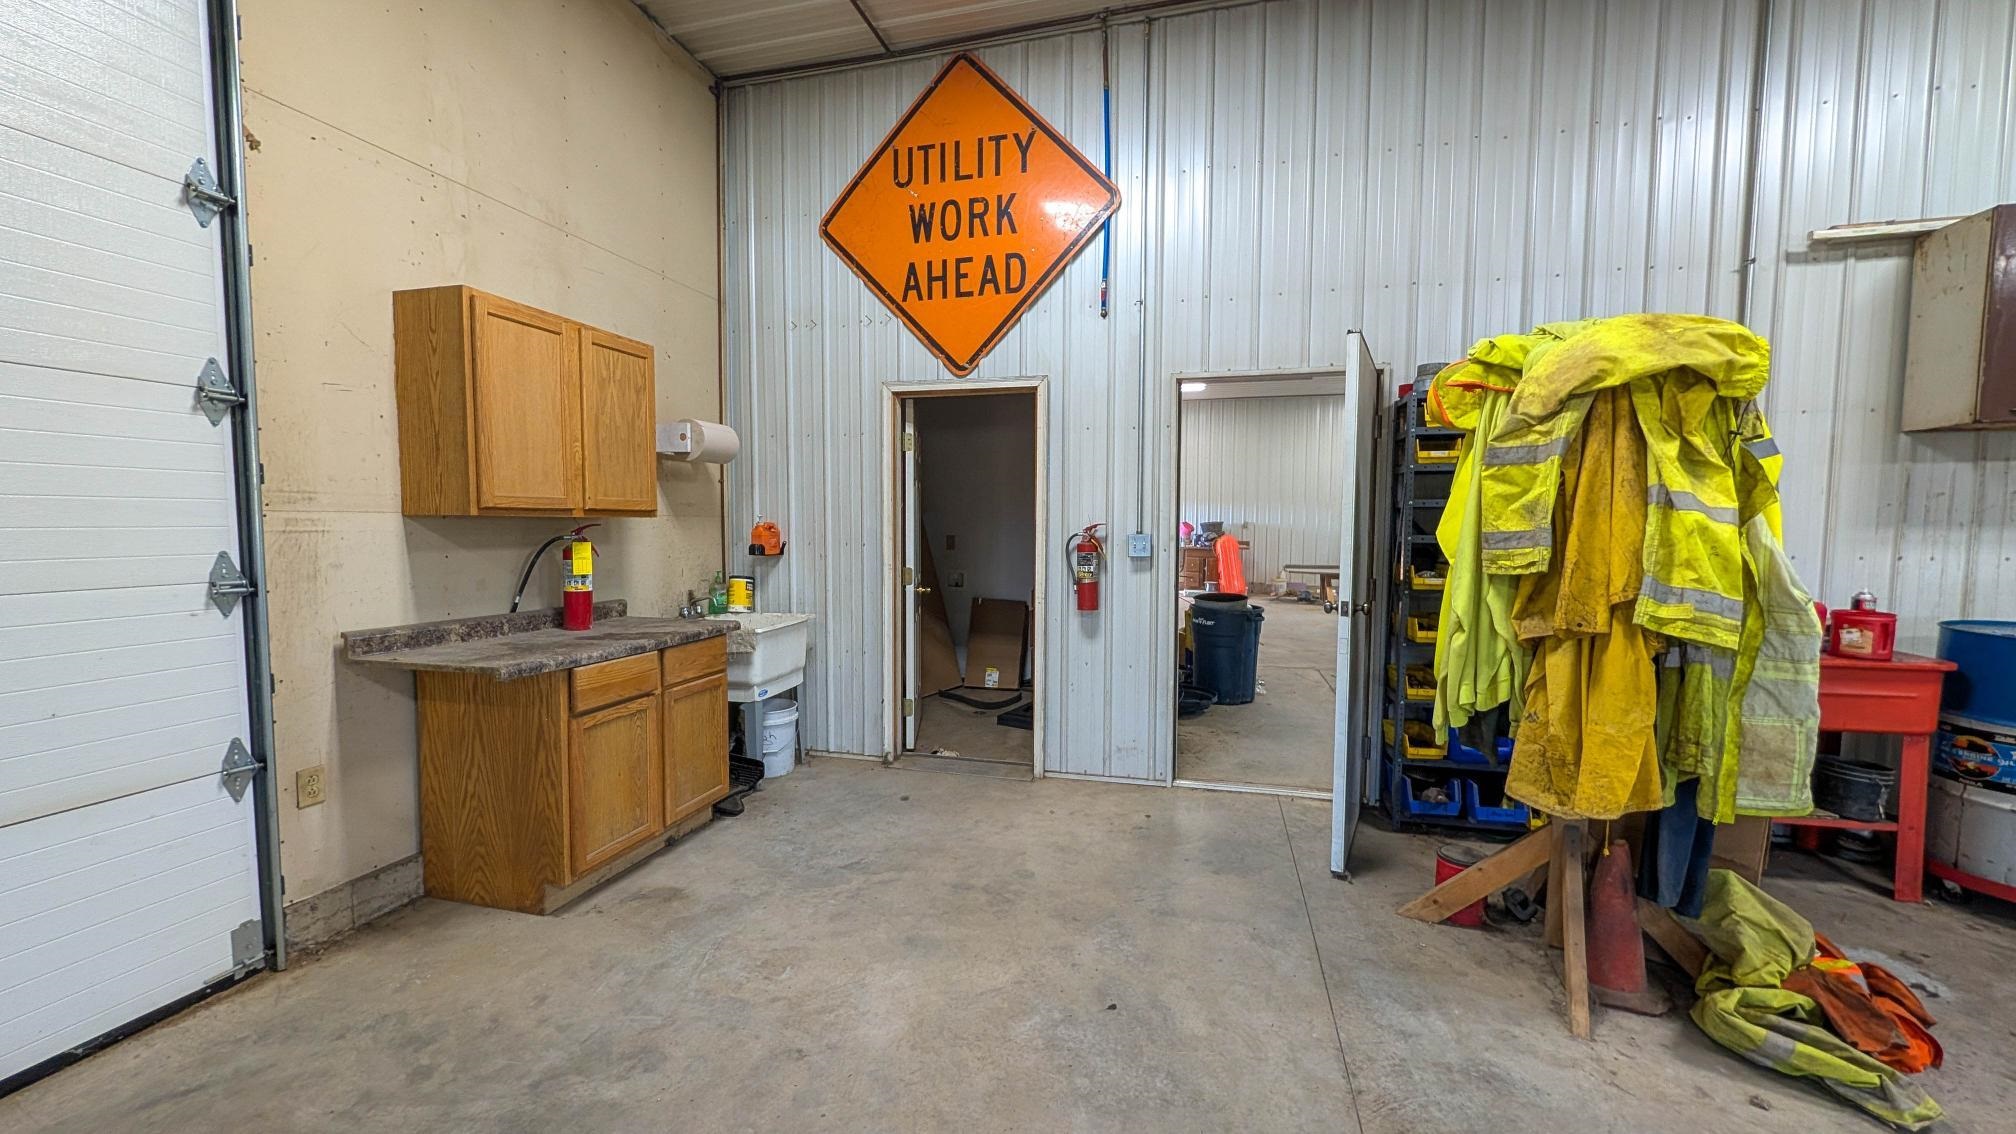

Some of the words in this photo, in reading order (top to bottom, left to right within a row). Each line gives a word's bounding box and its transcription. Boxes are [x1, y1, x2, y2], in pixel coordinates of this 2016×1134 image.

[892, 127, 1037, 188] UTILITY
[909, 192, 1018, 243] WORK
[901, 252, 1027, 302] AHEAD
